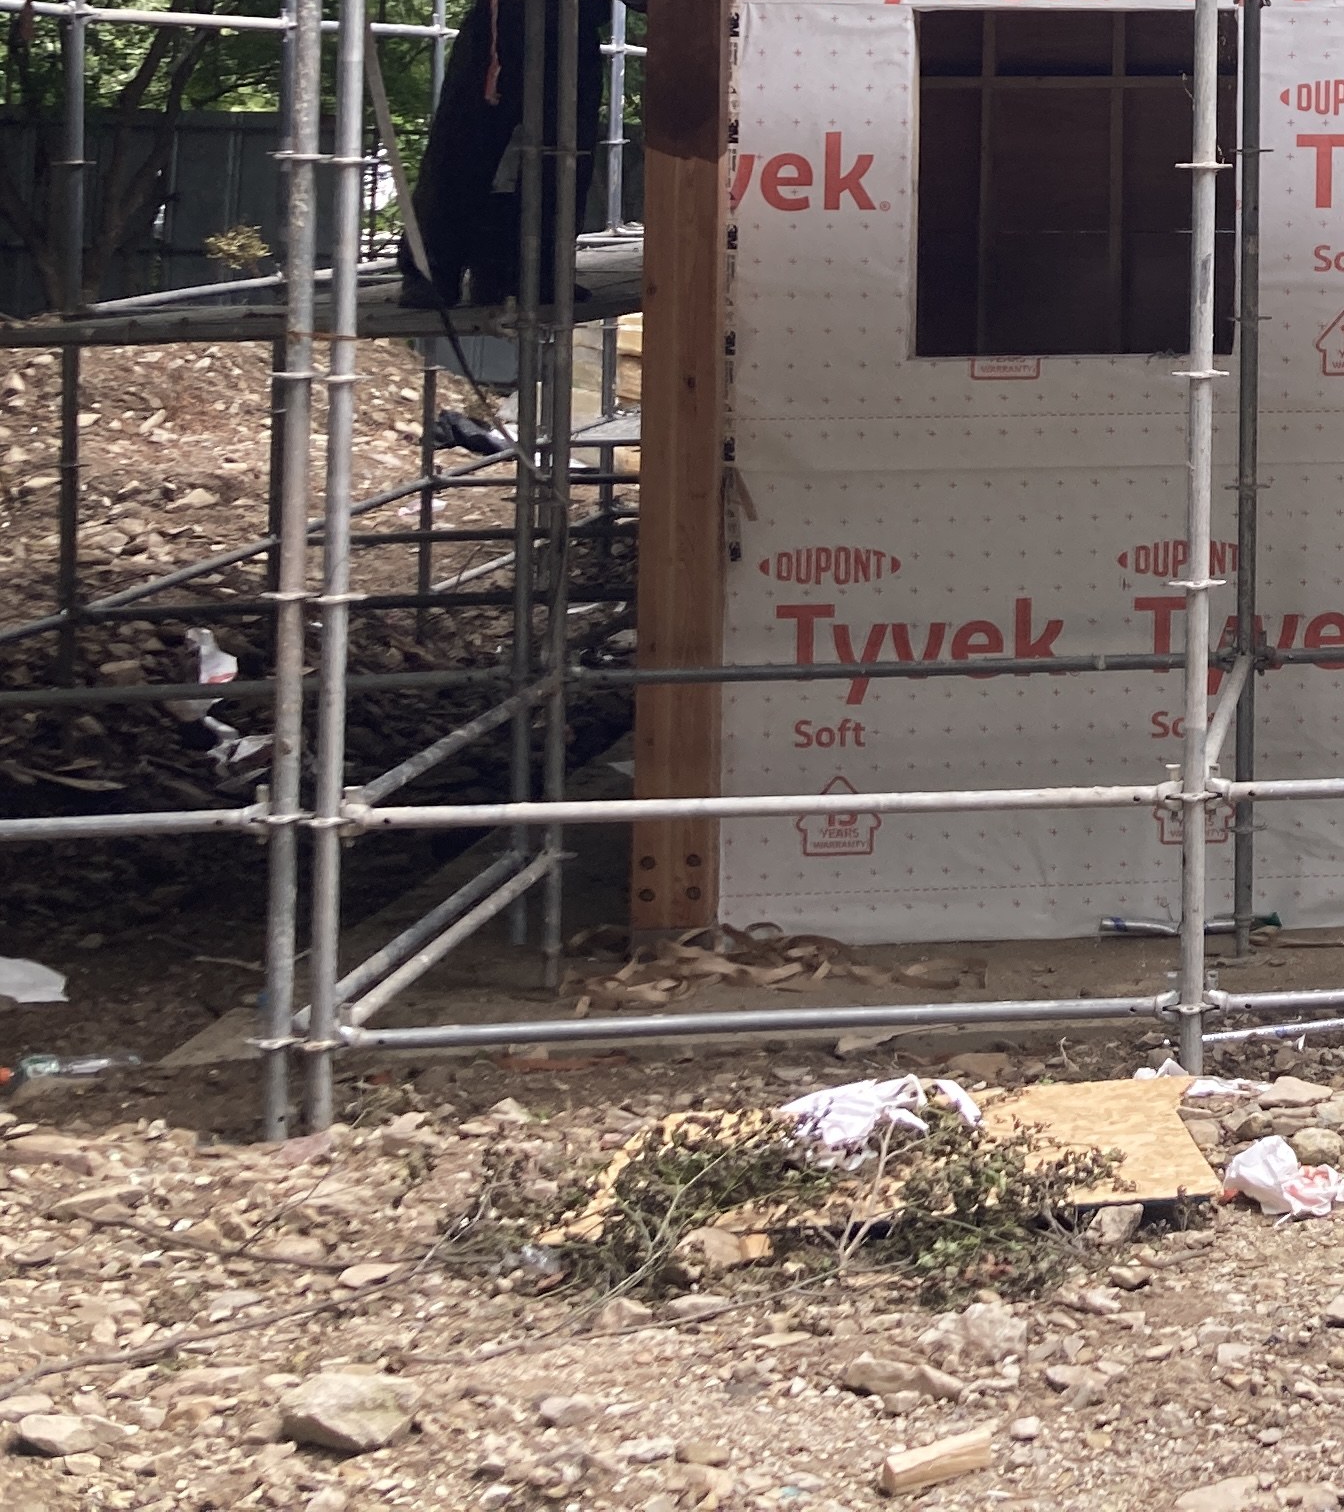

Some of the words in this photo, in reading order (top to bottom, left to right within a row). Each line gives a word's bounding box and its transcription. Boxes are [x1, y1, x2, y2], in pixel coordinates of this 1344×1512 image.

[776, 546, 886, 585] DUPONT
[1135, 539, 1238, 578] DUPNT
[776, 598, 1065, 705] Tyvek
[794, 720, 866, 749] Soft
[819, 828, 860, 840] YEARS
